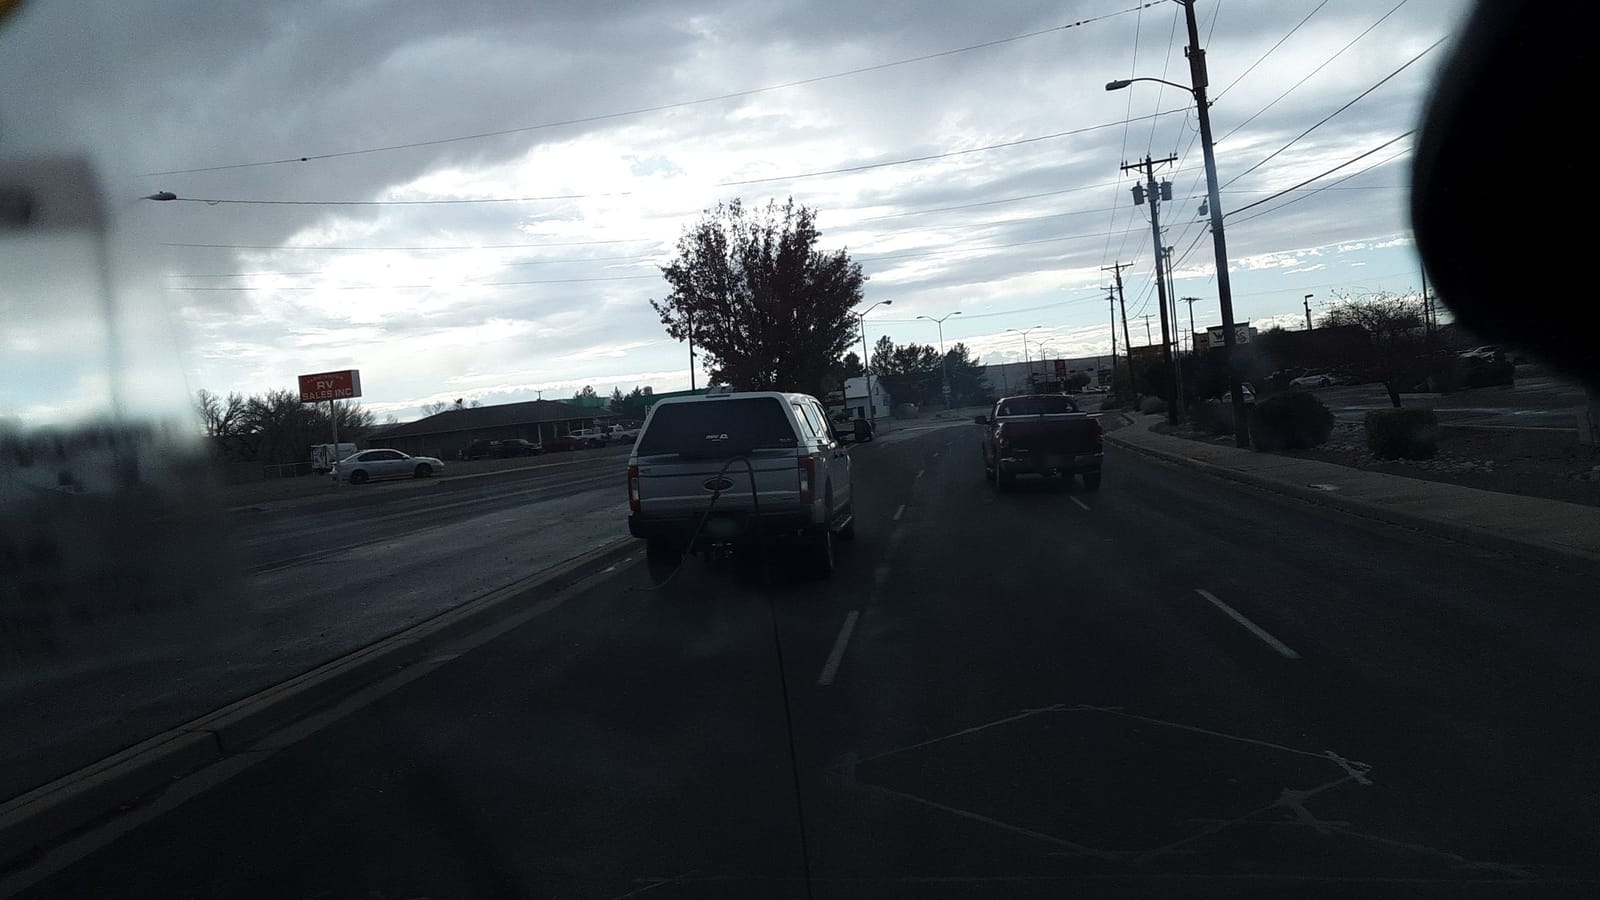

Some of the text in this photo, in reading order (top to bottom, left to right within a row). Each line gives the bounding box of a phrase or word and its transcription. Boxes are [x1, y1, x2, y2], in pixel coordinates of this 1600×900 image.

[316, 380, 334, 390] RV
[302, 387, 352, 401] SALES INC
